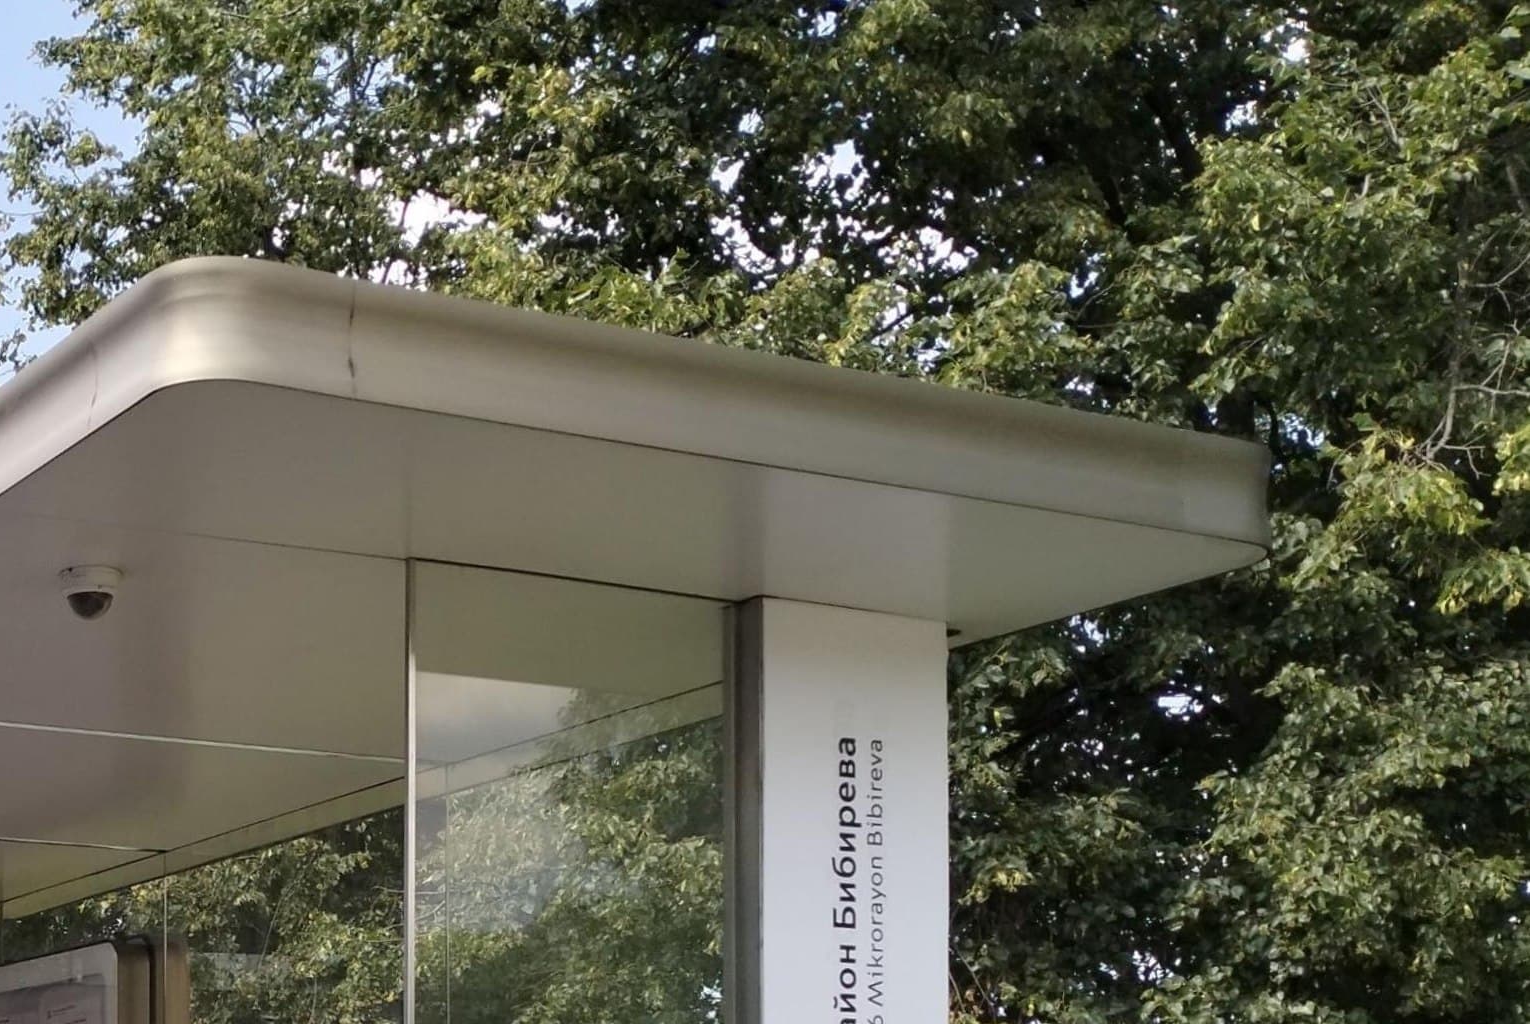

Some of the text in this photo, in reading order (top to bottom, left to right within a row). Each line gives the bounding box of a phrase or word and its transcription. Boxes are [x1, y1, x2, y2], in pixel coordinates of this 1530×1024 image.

[832, 737, 862, 930] Бибирева
[866, 738, 884, 846] Bibireva
[867, 856, 887, 1007] Mikrorayon
